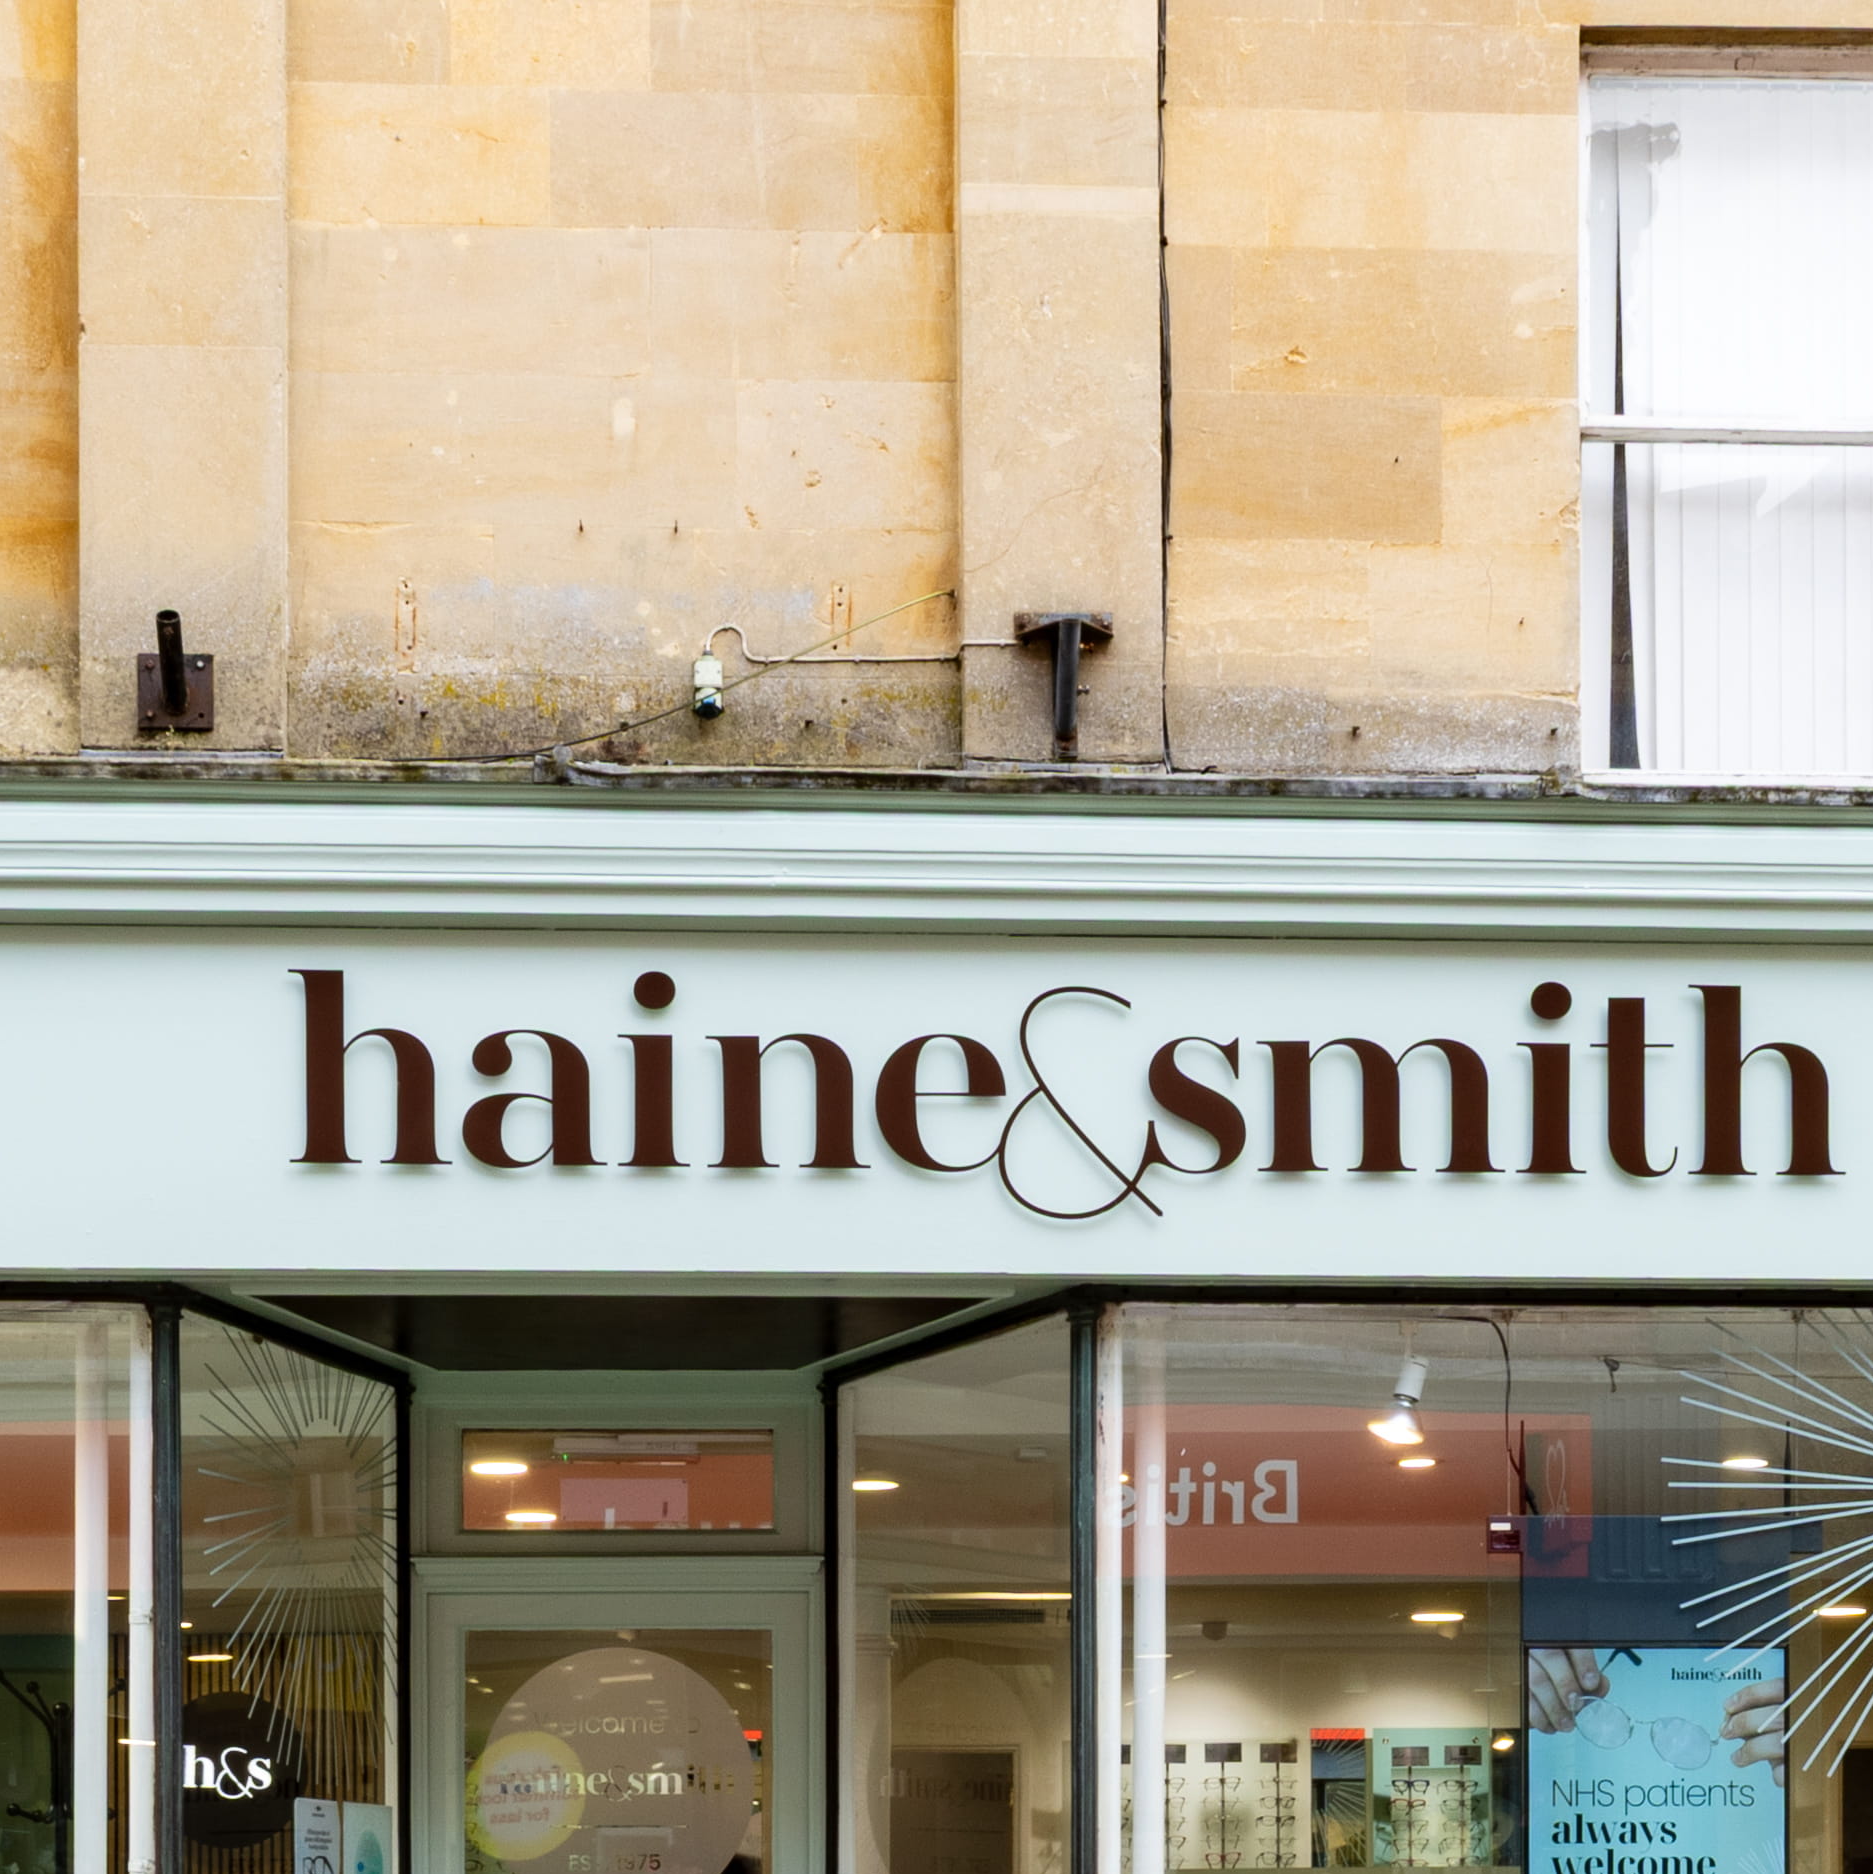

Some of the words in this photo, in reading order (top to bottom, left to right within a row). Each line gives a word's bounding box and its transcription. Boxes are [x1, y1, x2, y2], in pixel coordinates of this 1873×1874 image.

[287, 967, 1845, 1220] haine&smith
[183, 1744, 272, 1799] h&s
[1552, 1779, 1615, 1807] NHS
[1625, 1778, 1755, 1816] patients
[1551, 1814, 1677, 1853] always
